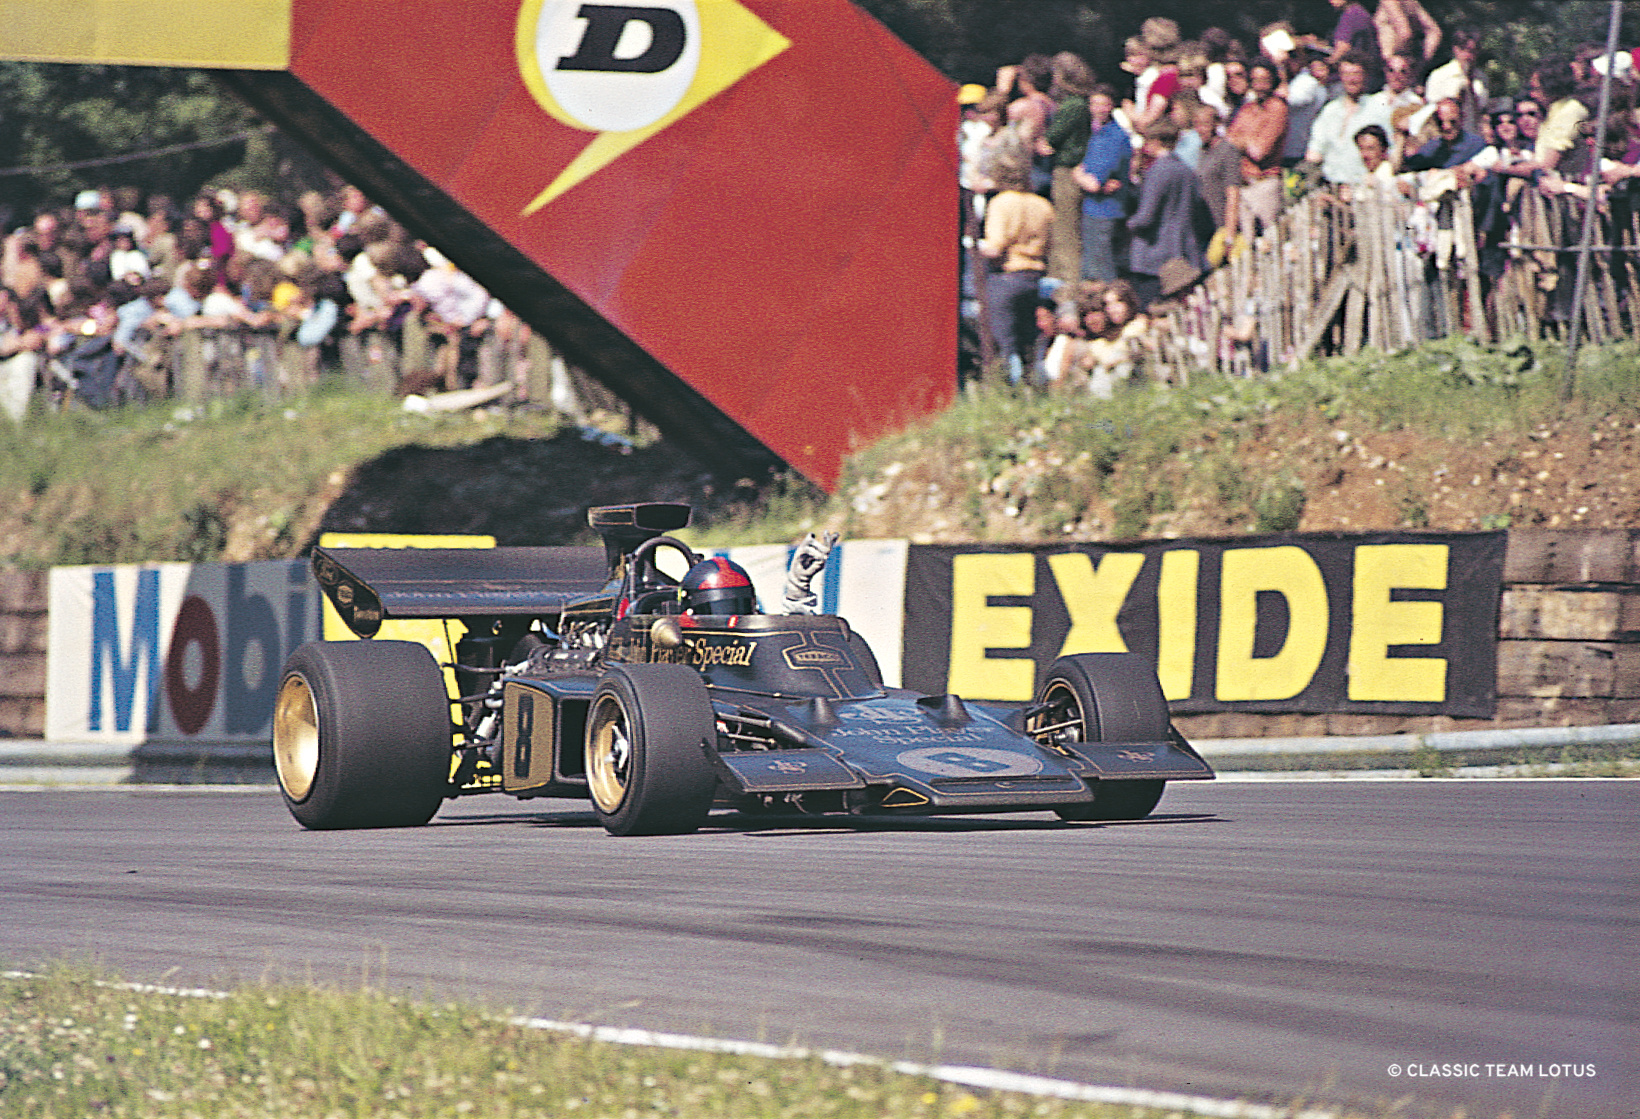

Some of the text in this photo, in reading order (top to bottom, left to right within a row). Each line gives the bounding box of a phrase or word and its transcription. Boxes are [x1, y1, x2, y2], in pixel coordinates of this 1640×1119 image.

[555, 4, 687, 73] D
[88, 562, 323, 734] Mobi
[693, 637, 757, 672] Special
[947, 543, 1450, 702] EXIDE
[513, 693, 534, 778] 8
